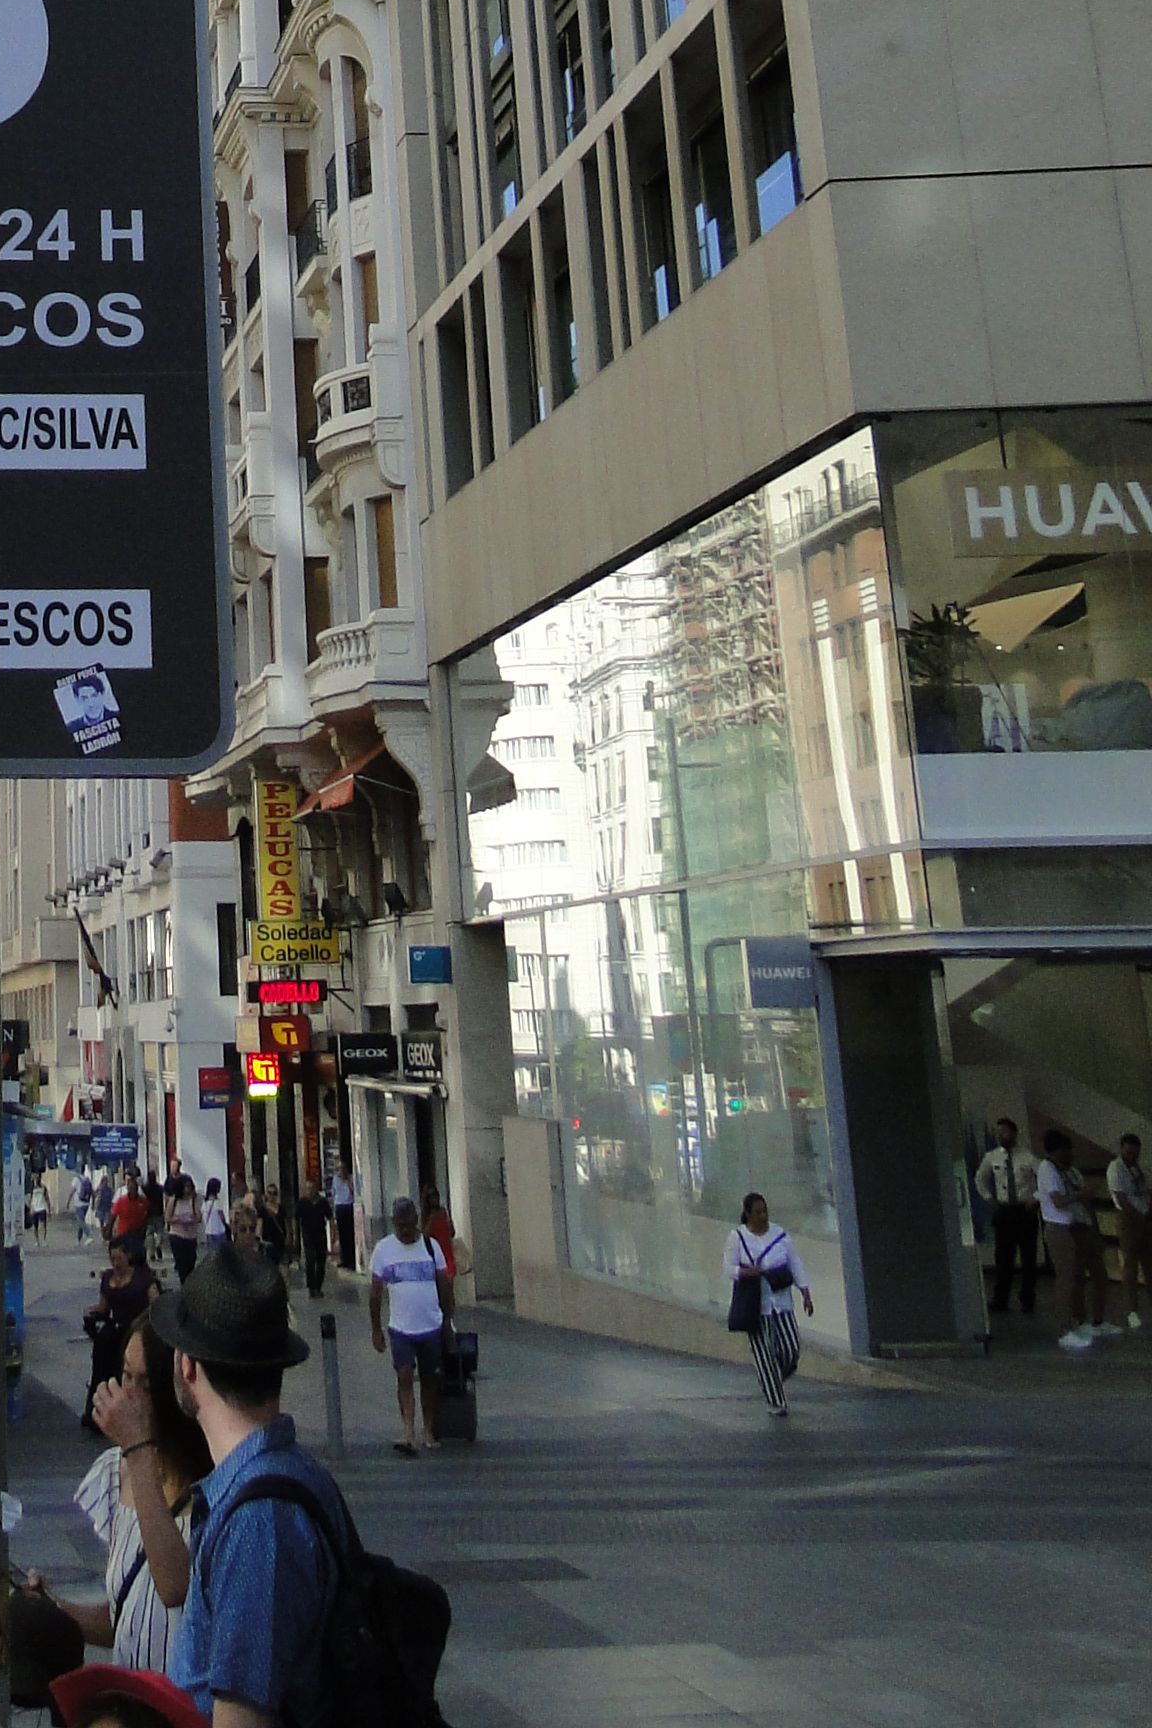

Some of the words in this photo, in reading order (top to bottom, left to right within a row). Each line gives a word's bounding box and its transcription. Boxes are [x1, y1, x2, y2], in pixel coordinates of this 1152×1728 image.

[100, 208, 145, 261] H
[73, 717, 121, 743] FASCISTA
[263, 783, 295, 916] PELUCAS
[257, 924, 333, 941] Soledad
[260, 944, 331, 962] Cabello
[751, 966, 812, 980] HUAWEI
[343, 1048, 389, 1058] GEOX
[407, 1042, 437, 1067] GEOX
